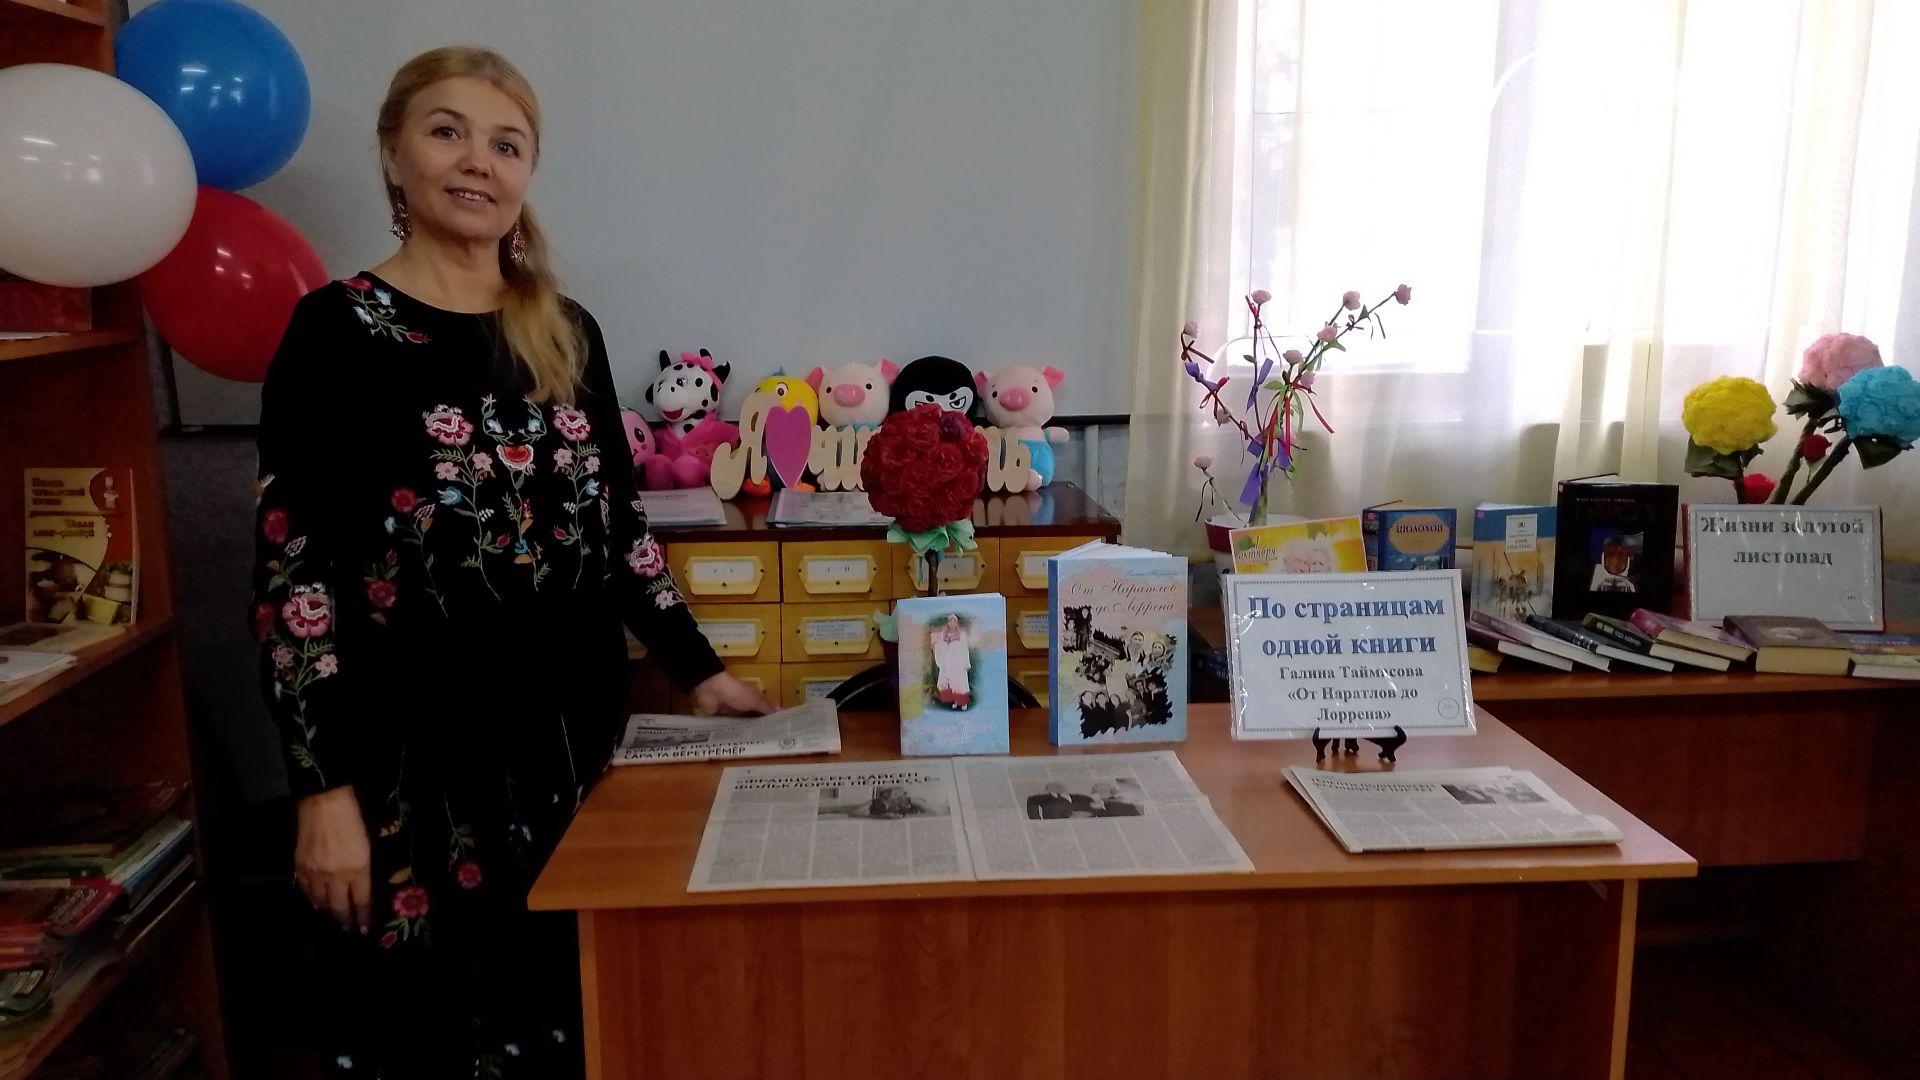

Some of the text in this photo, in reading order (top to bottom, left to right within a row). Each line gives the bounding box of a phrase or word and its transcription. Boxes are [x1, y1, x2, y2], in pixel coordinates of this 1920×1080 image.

[1395, 523, 1444, 534] ШОЛОХОВ
[1700, 515, 1775, 535] Жизни
[1733, 550, 1834, 566] листопад
[1247, 595, 1446, 624] По страницам
[1261, 633, 1438, 659] одной книги
[1279, 665, 1336, 680] Галина
[1287, 686, 1419, 703] «От Наратлов до
[1316, 707, 1392, 724] Лоррена»
